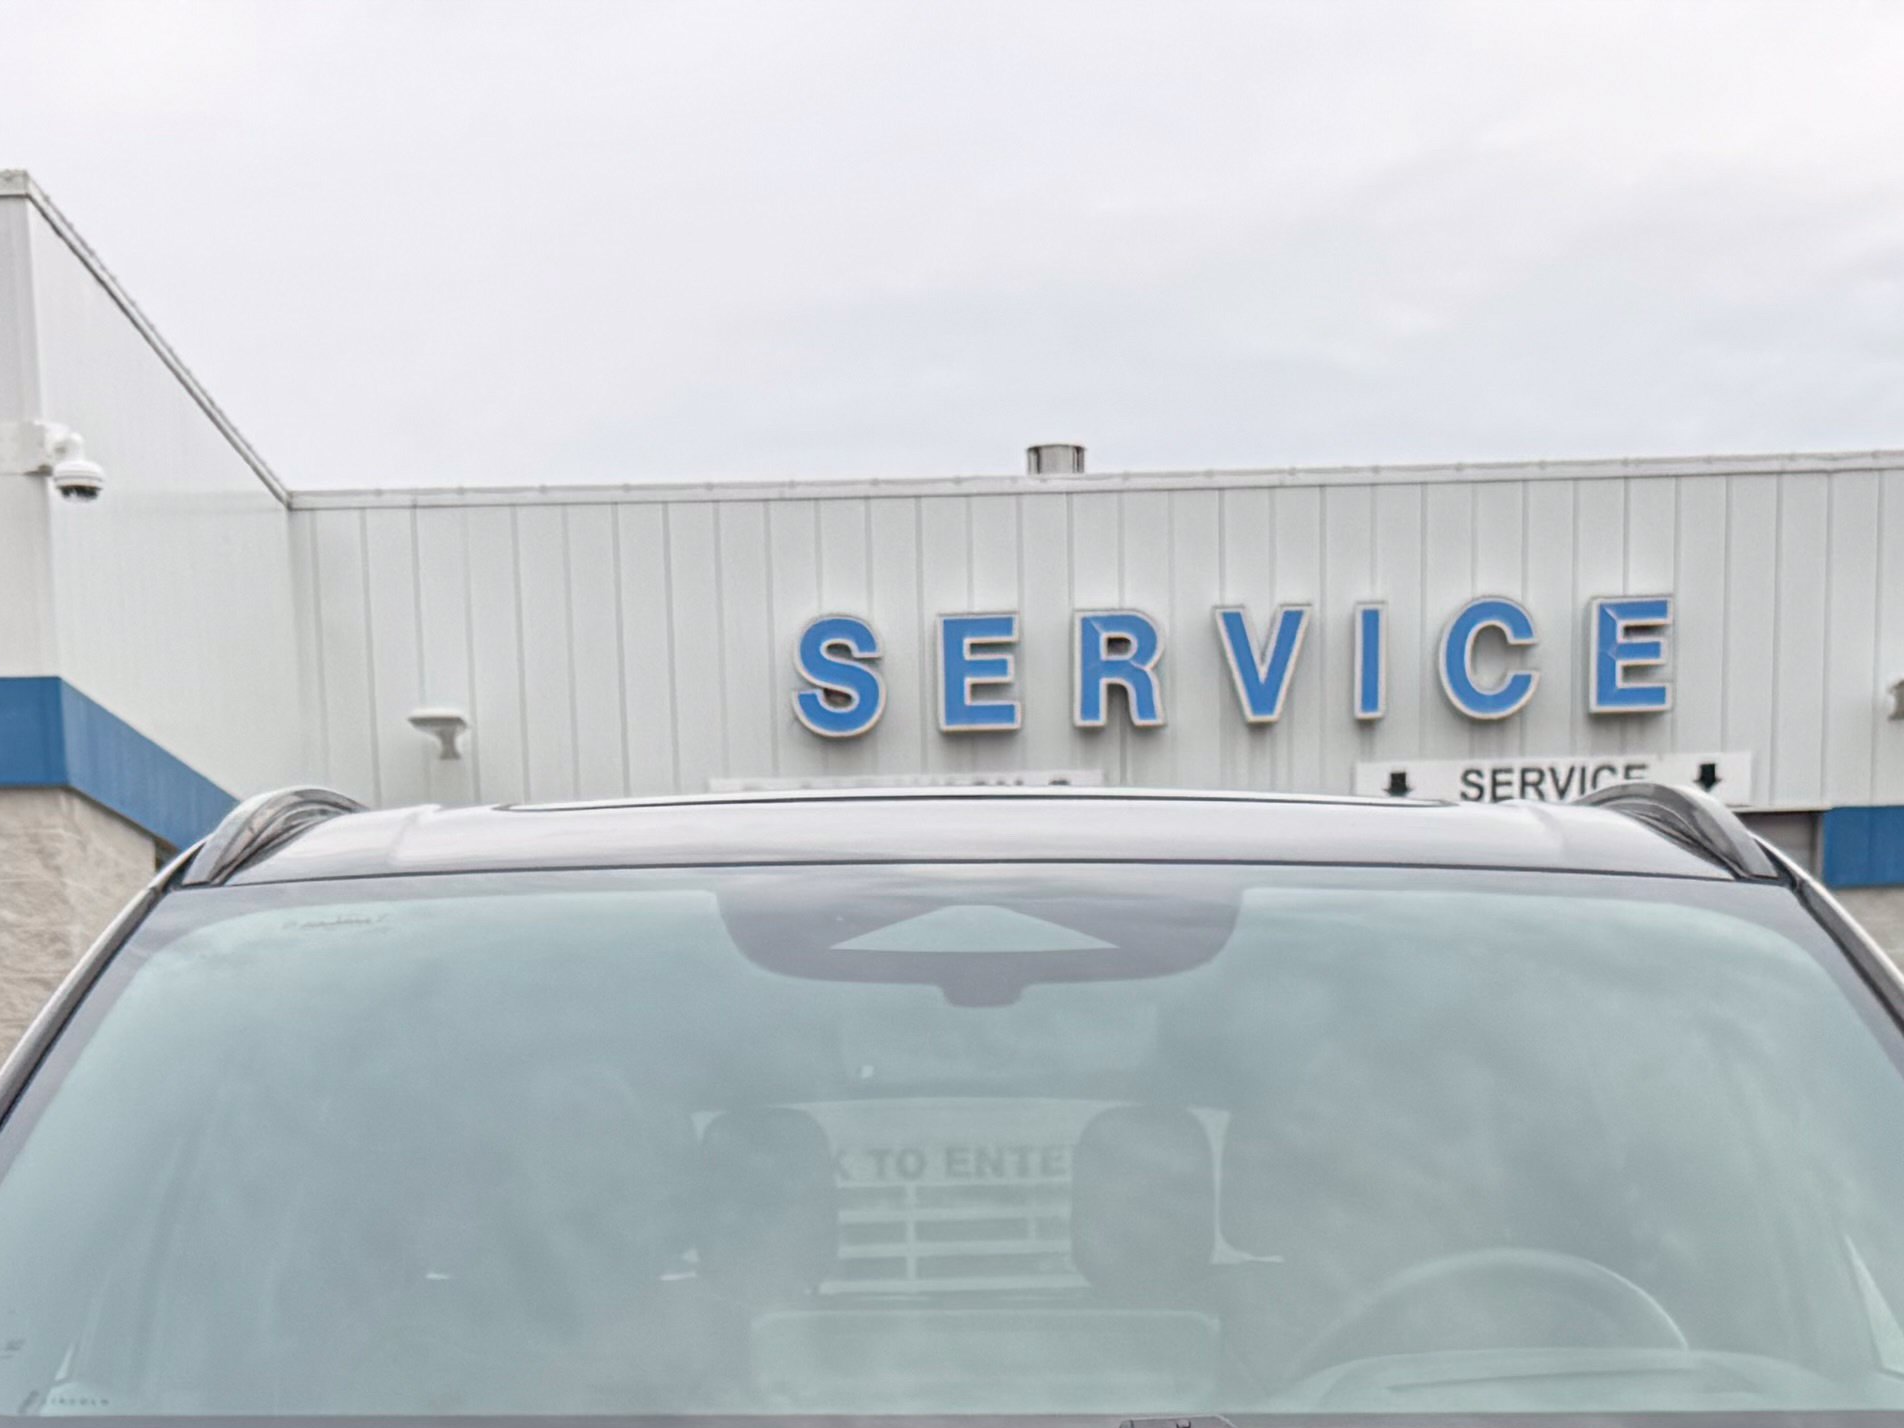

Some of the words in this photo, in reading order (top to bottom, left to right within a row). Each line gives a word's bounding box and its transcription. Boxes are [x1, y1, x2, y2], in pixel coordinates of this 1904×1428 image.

[792, 594, 1675, 738] SERVICE
[866, 1147, 927, 1181] TO
[944, 1145, 1069, 1179] ENTE
